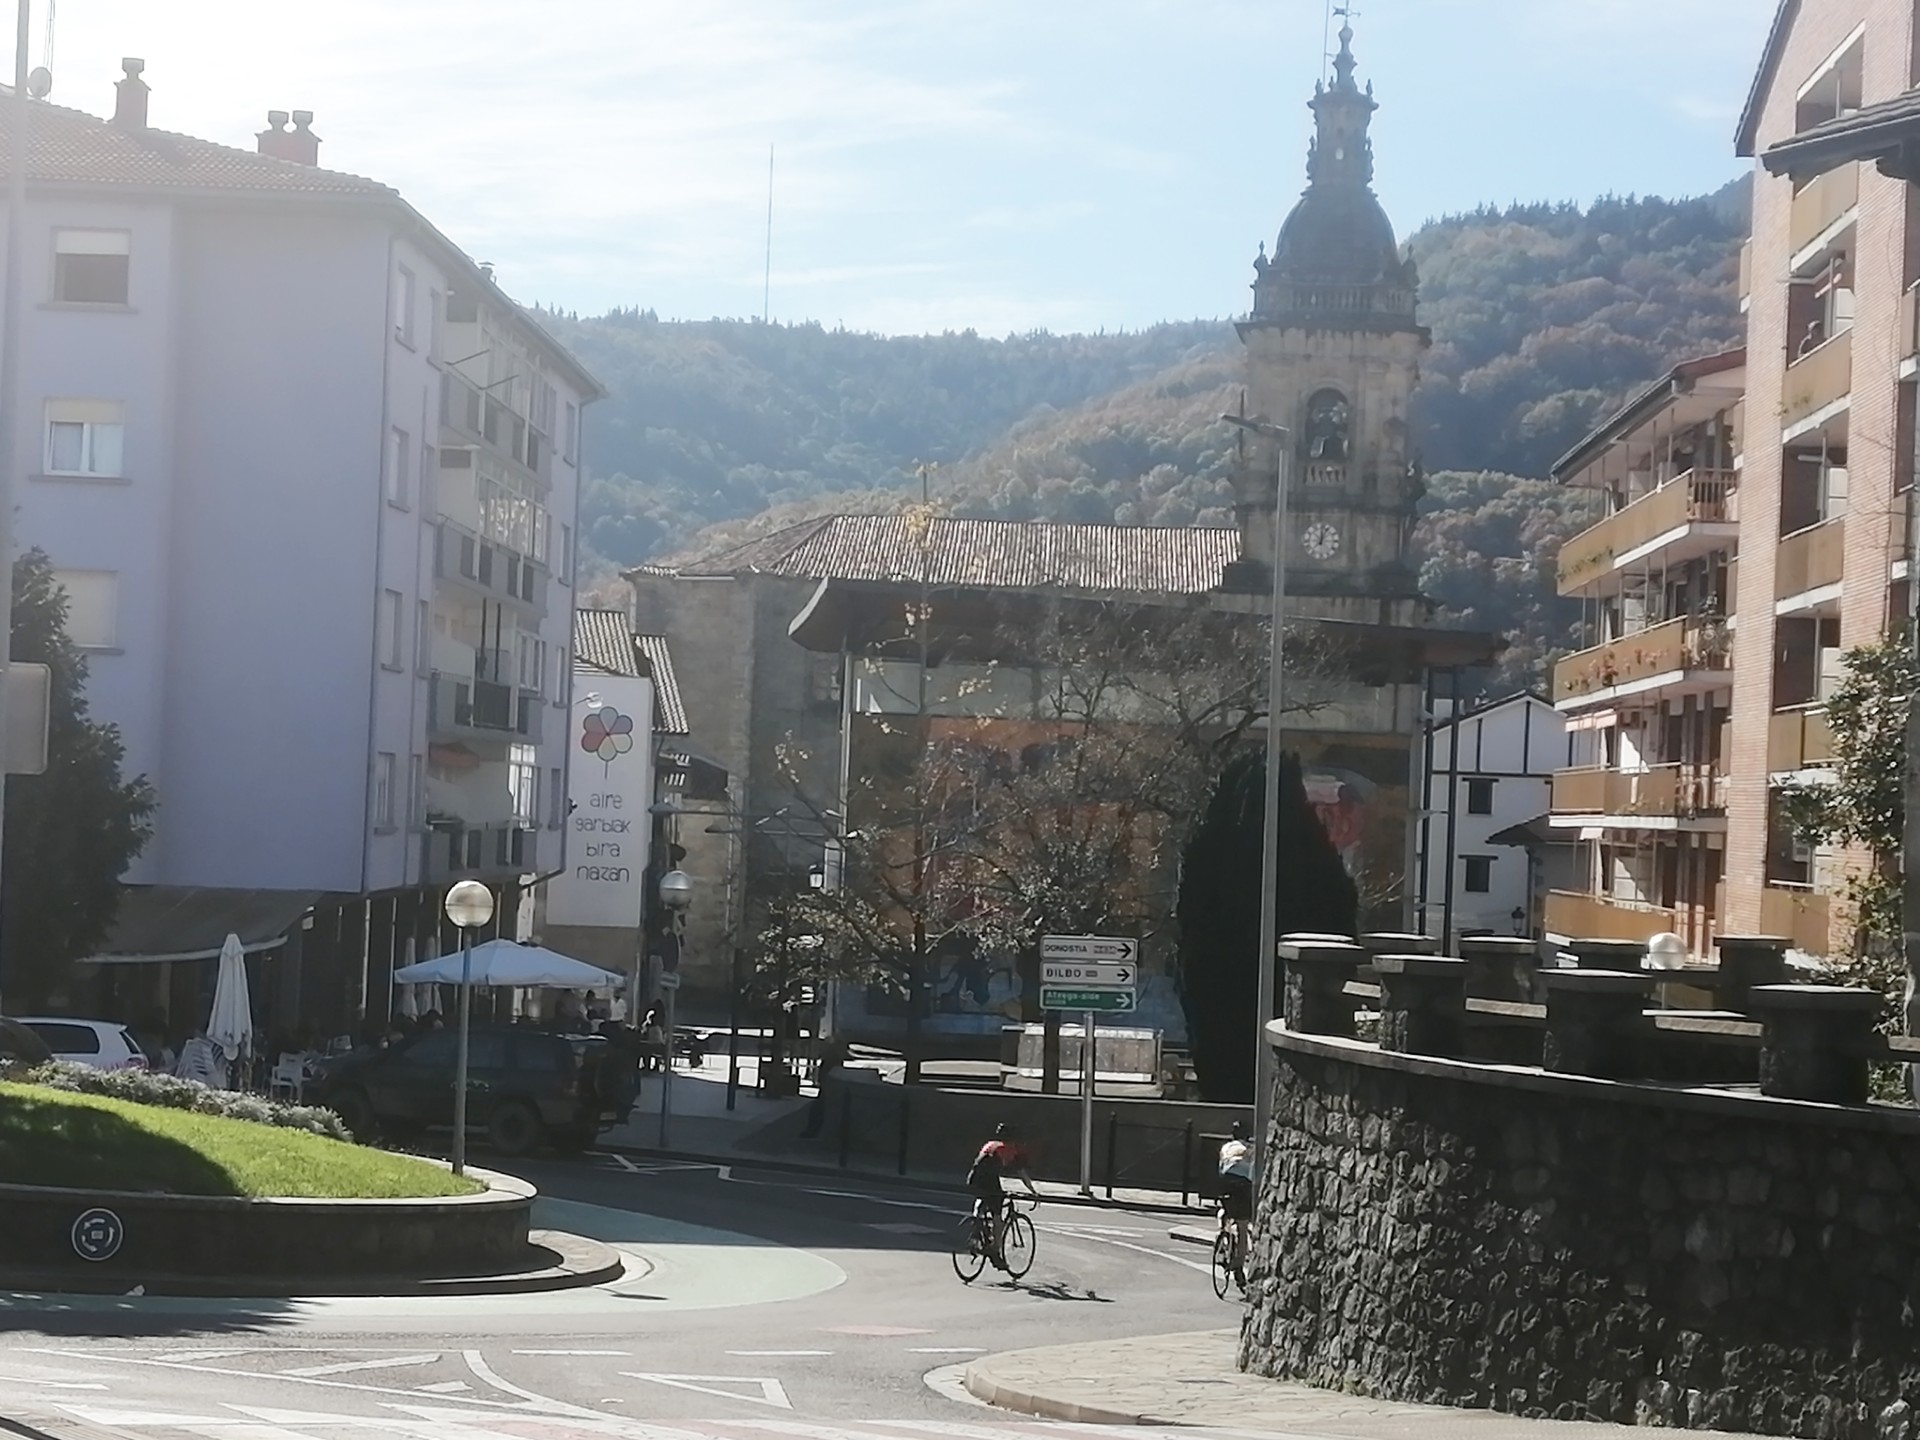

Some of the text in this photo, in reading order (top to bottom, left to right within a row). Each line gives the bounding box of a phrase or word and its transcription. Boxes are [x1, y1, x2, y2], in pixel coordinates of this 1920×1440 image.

[590, 792, 623, 810] aire
[586, 841, 621, 858] bira
[576, 865, 631, 883] nazan
[1044, 944, 1088, 953] DONOSTIA
[1046, 967, 1082, 978] BILBO
